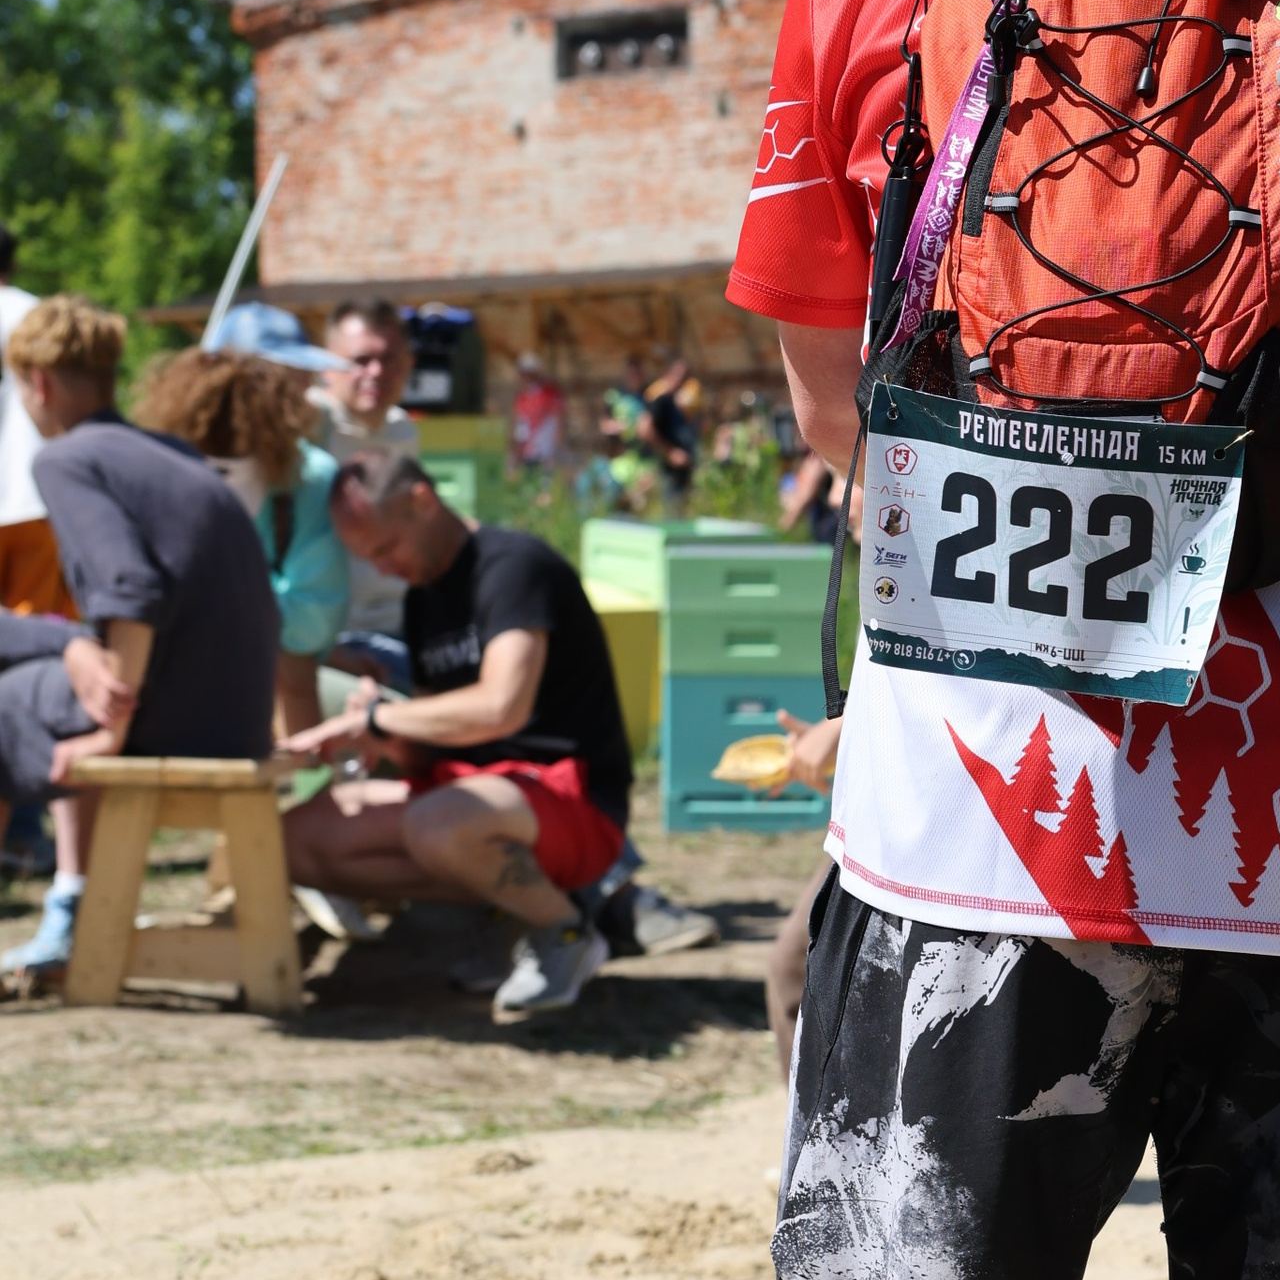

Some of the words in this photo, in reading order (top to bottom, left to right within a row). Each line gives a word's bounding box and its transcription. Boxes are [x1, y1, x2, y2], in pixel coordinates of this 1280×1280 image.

[958, 410, 1141, 461] РЕМЕСЛЕННАЯ
[1158, 445, 1175, 464] 15
[1170, 478, 1228, 496] НОЧНАЯ
[1175, 491, 1222, 506] ПЧЕЛА
[930, 471, 1155, 624] 222
[893, 642, 913, 658] 818
[915, 645, 934, 660] 915
[937, 648, 951, 662] +7
